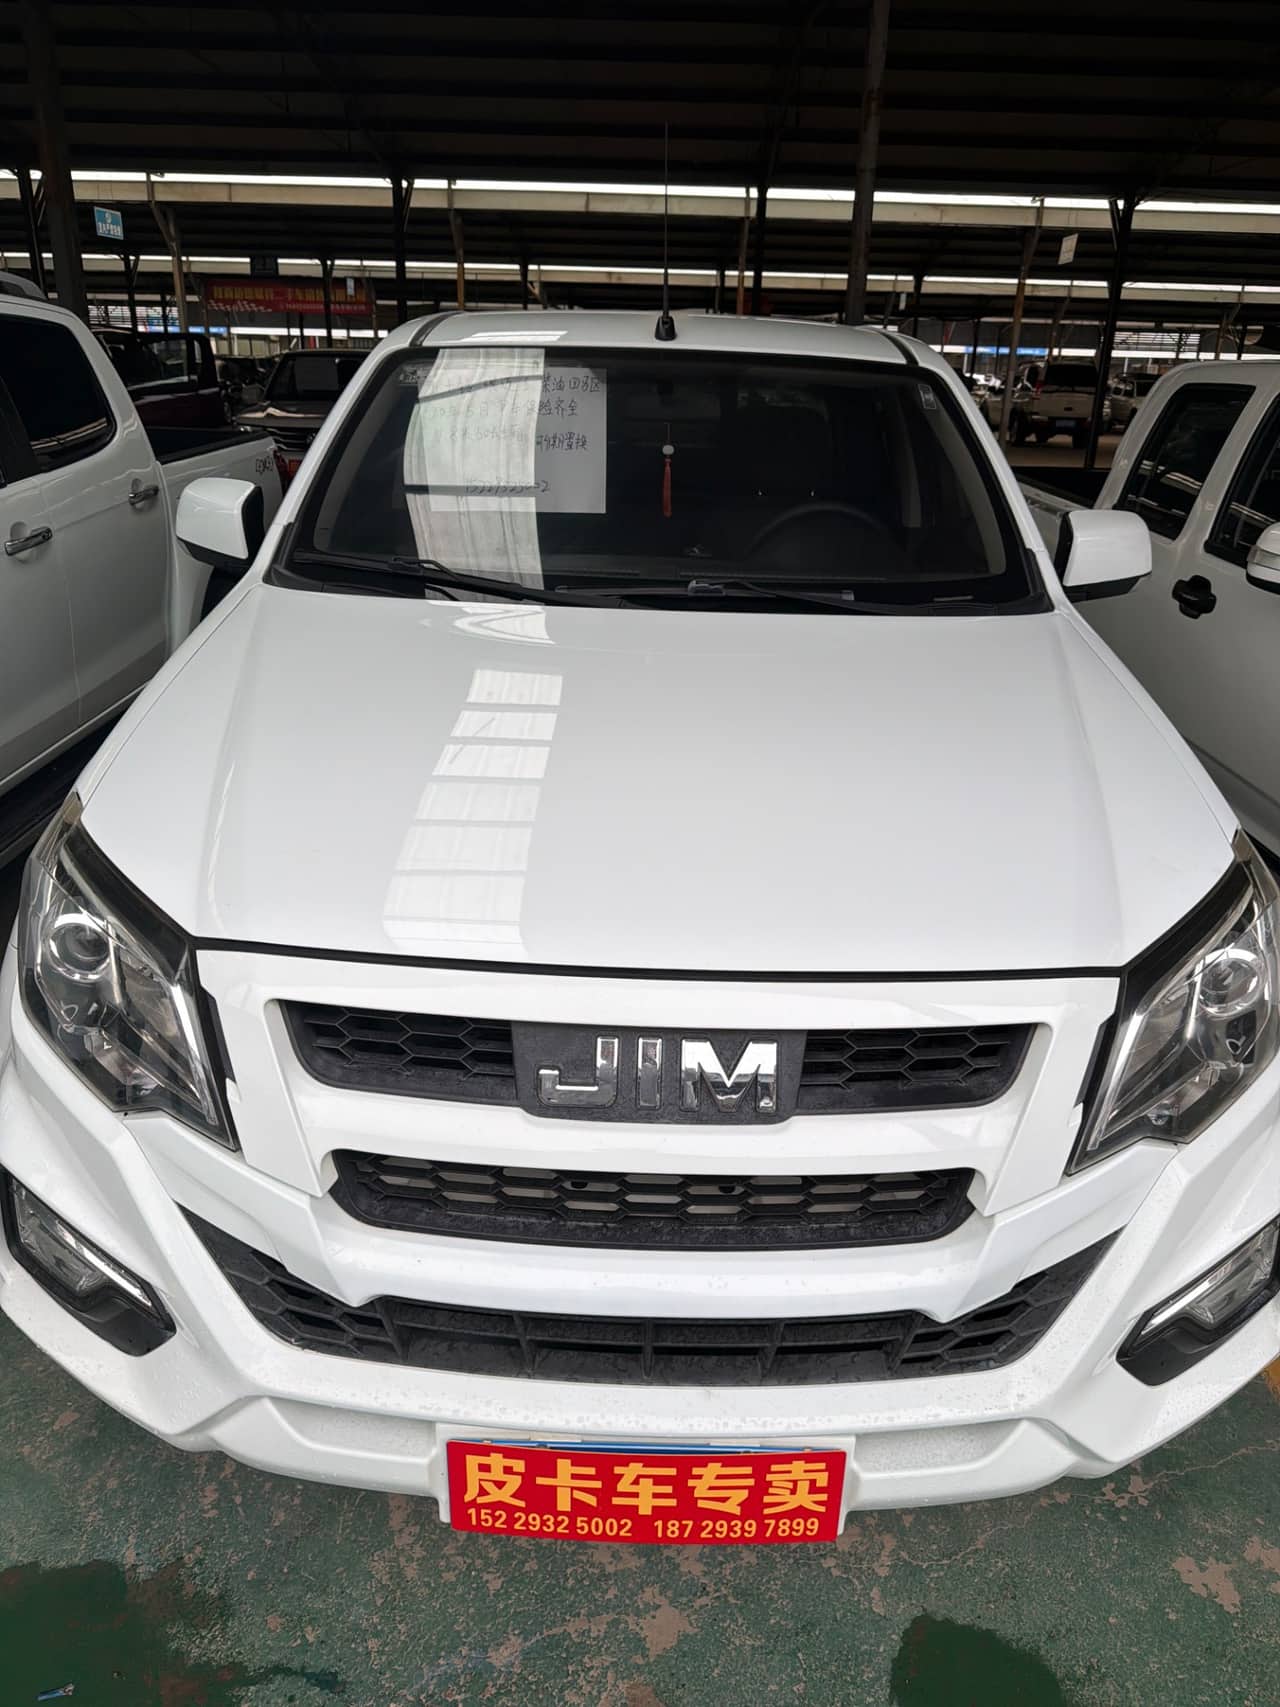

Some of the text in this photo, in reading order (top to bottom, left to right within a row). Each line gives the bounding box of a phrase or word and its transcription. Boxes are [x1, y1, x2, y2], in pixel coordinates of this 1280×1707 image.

[538, 1036, 778, 1112] JIM
[463, 1452, 829, 1515] 皮卡车专卖
[467, 1507, 819, 1538] 152 2932 5002 187 2939 7899
